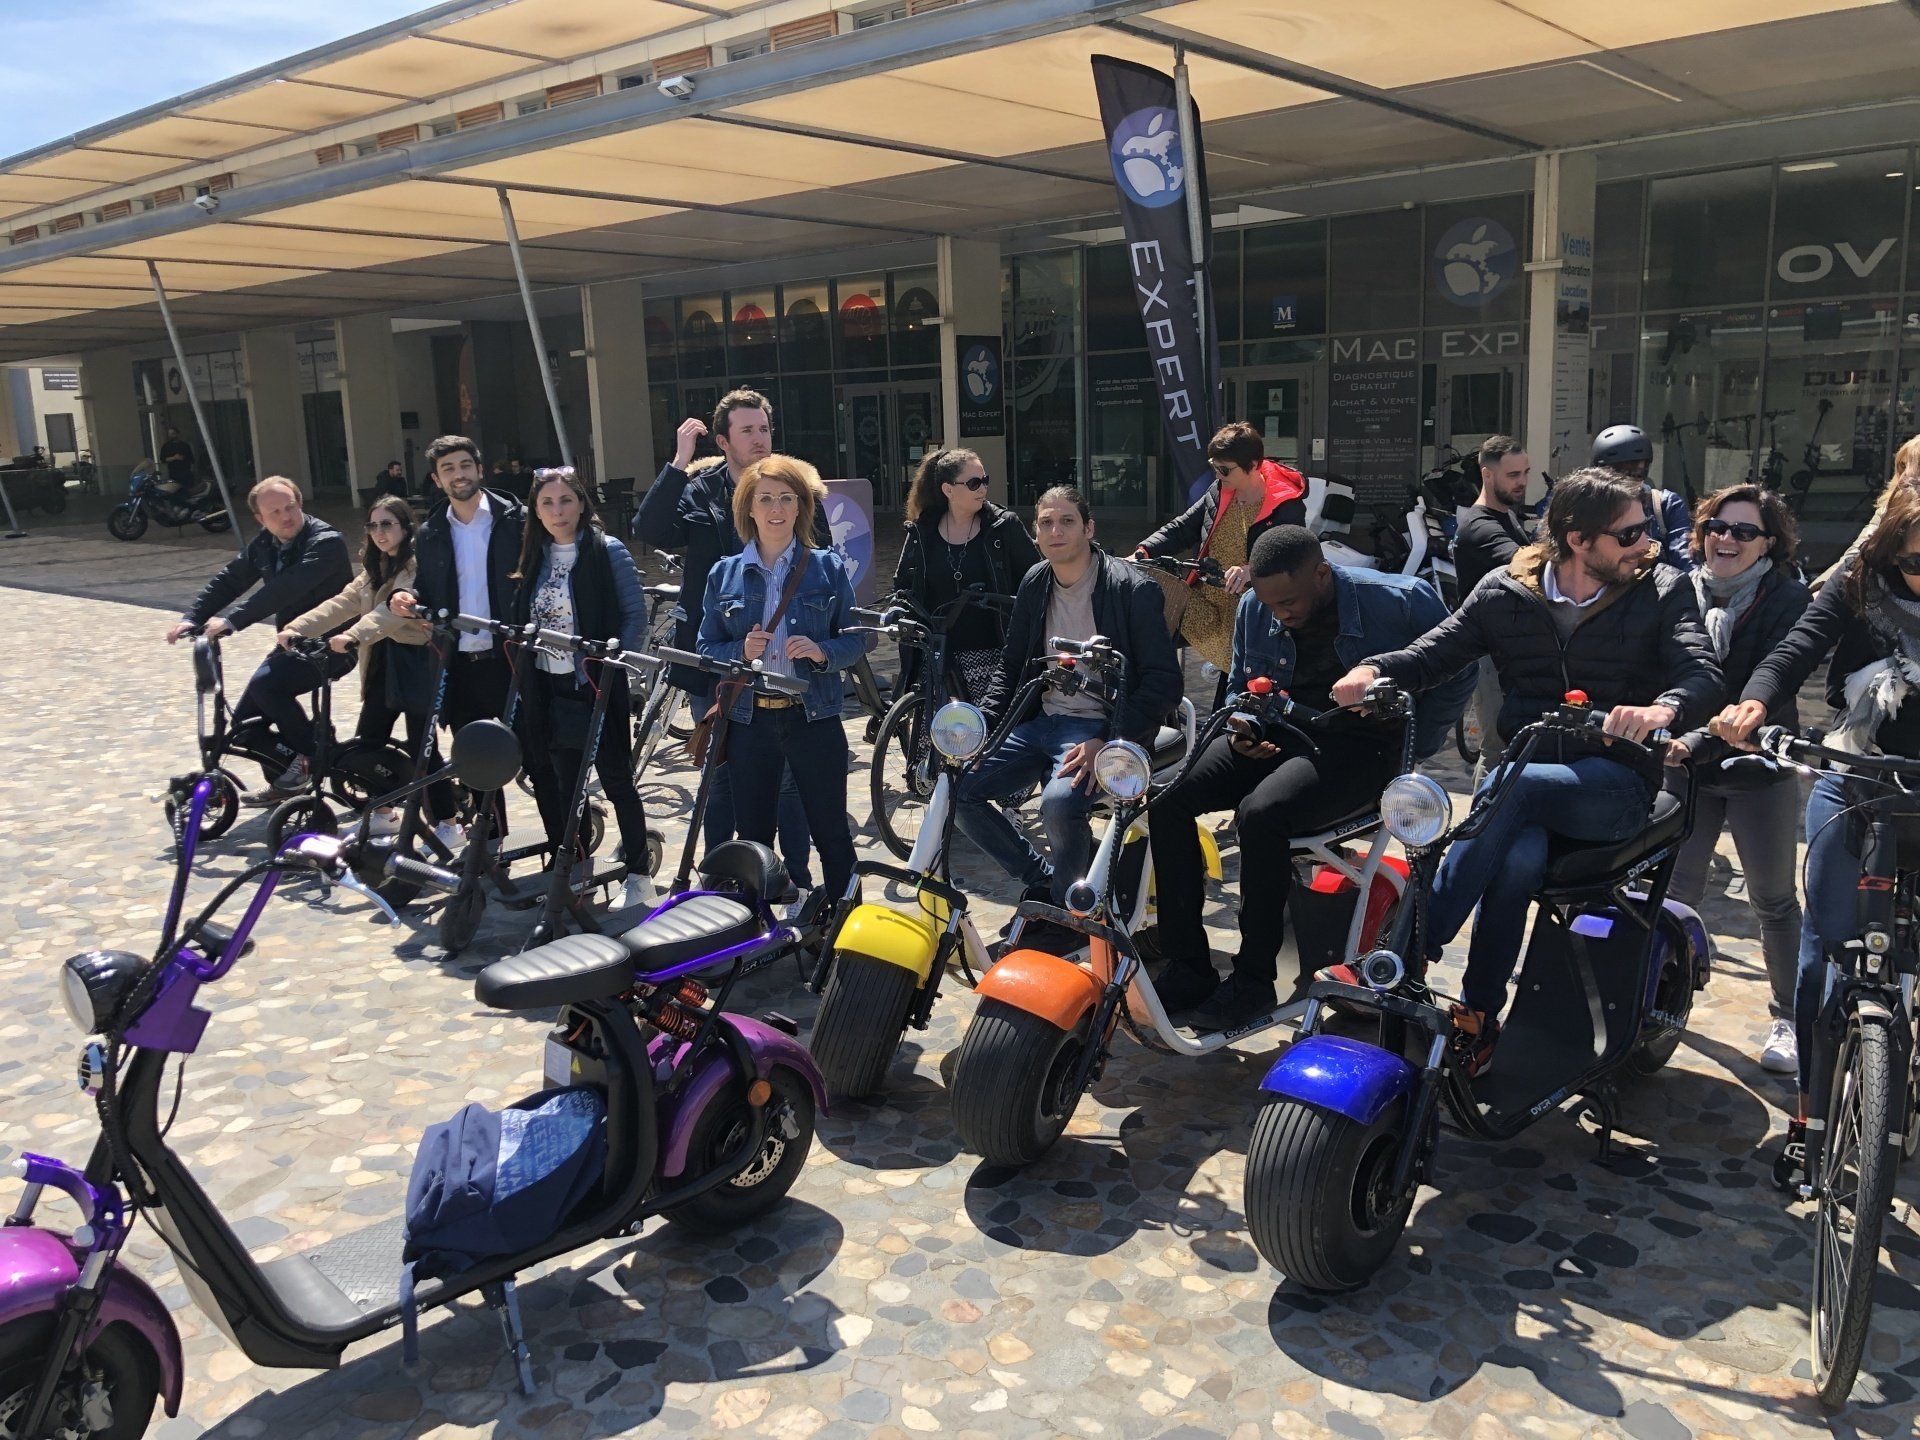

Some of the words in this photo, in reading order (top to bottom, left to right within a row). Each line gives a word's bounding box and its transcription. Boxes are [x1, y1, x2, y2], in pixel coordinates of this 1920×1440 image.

[1561, 232, 1591, 257] Vente
[1777, 238, 1898, 283] OV
[1130, 239, 1201, 451] EXPERT
[1333, 337, 1415, 363] MAC
[1333, 370, 1415, 381] DIAGNOSTIQUE
[1350, 382, 1397, 391] GRATUIT
[1331, 399, 1366, 407] ACHAT
[1382, 397, 1417, 405] VENTE
[1333, 438, 1370, 446] BOOSTER
[1627, 859, 1650, 878] OVER
[1530, 1098, 1552, 1116] OVER
